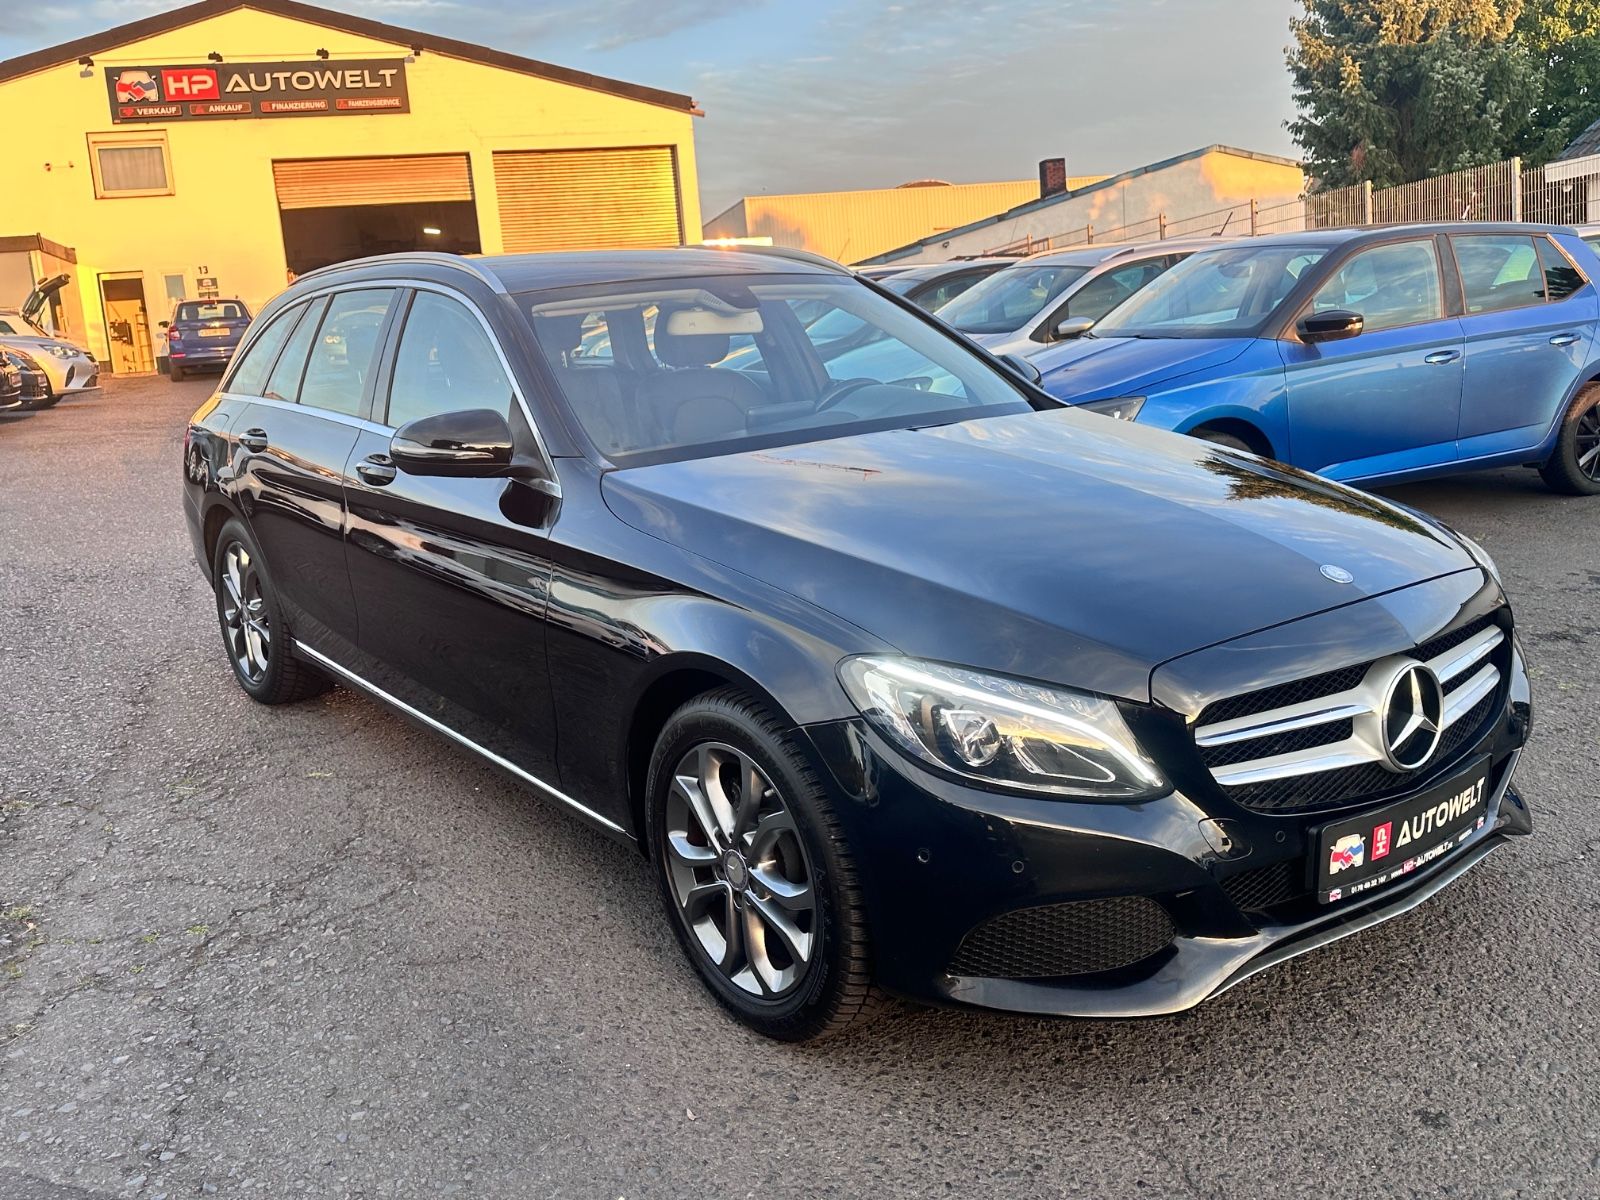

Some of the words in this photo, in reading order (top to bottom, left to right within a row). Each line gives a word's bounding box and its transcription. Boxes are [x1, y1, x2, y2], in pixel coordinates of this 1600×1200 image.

[167, 75, 214, 95] HP
[225, 69, 398, 93] AUTOWELT
[271, 101, 326, 110] FINANZIERUNG
[347, 98, 401, 107] FAHRZEUGSERVICE
[137, 107, 177, 115] VERKAUF
[208, 104, 243, 112] ANKAUF
[198, 265, 209, 274] 13
[1376, 828, 1388, 856] HP
[1395, 776, 1486, 849] AUTOWELT
